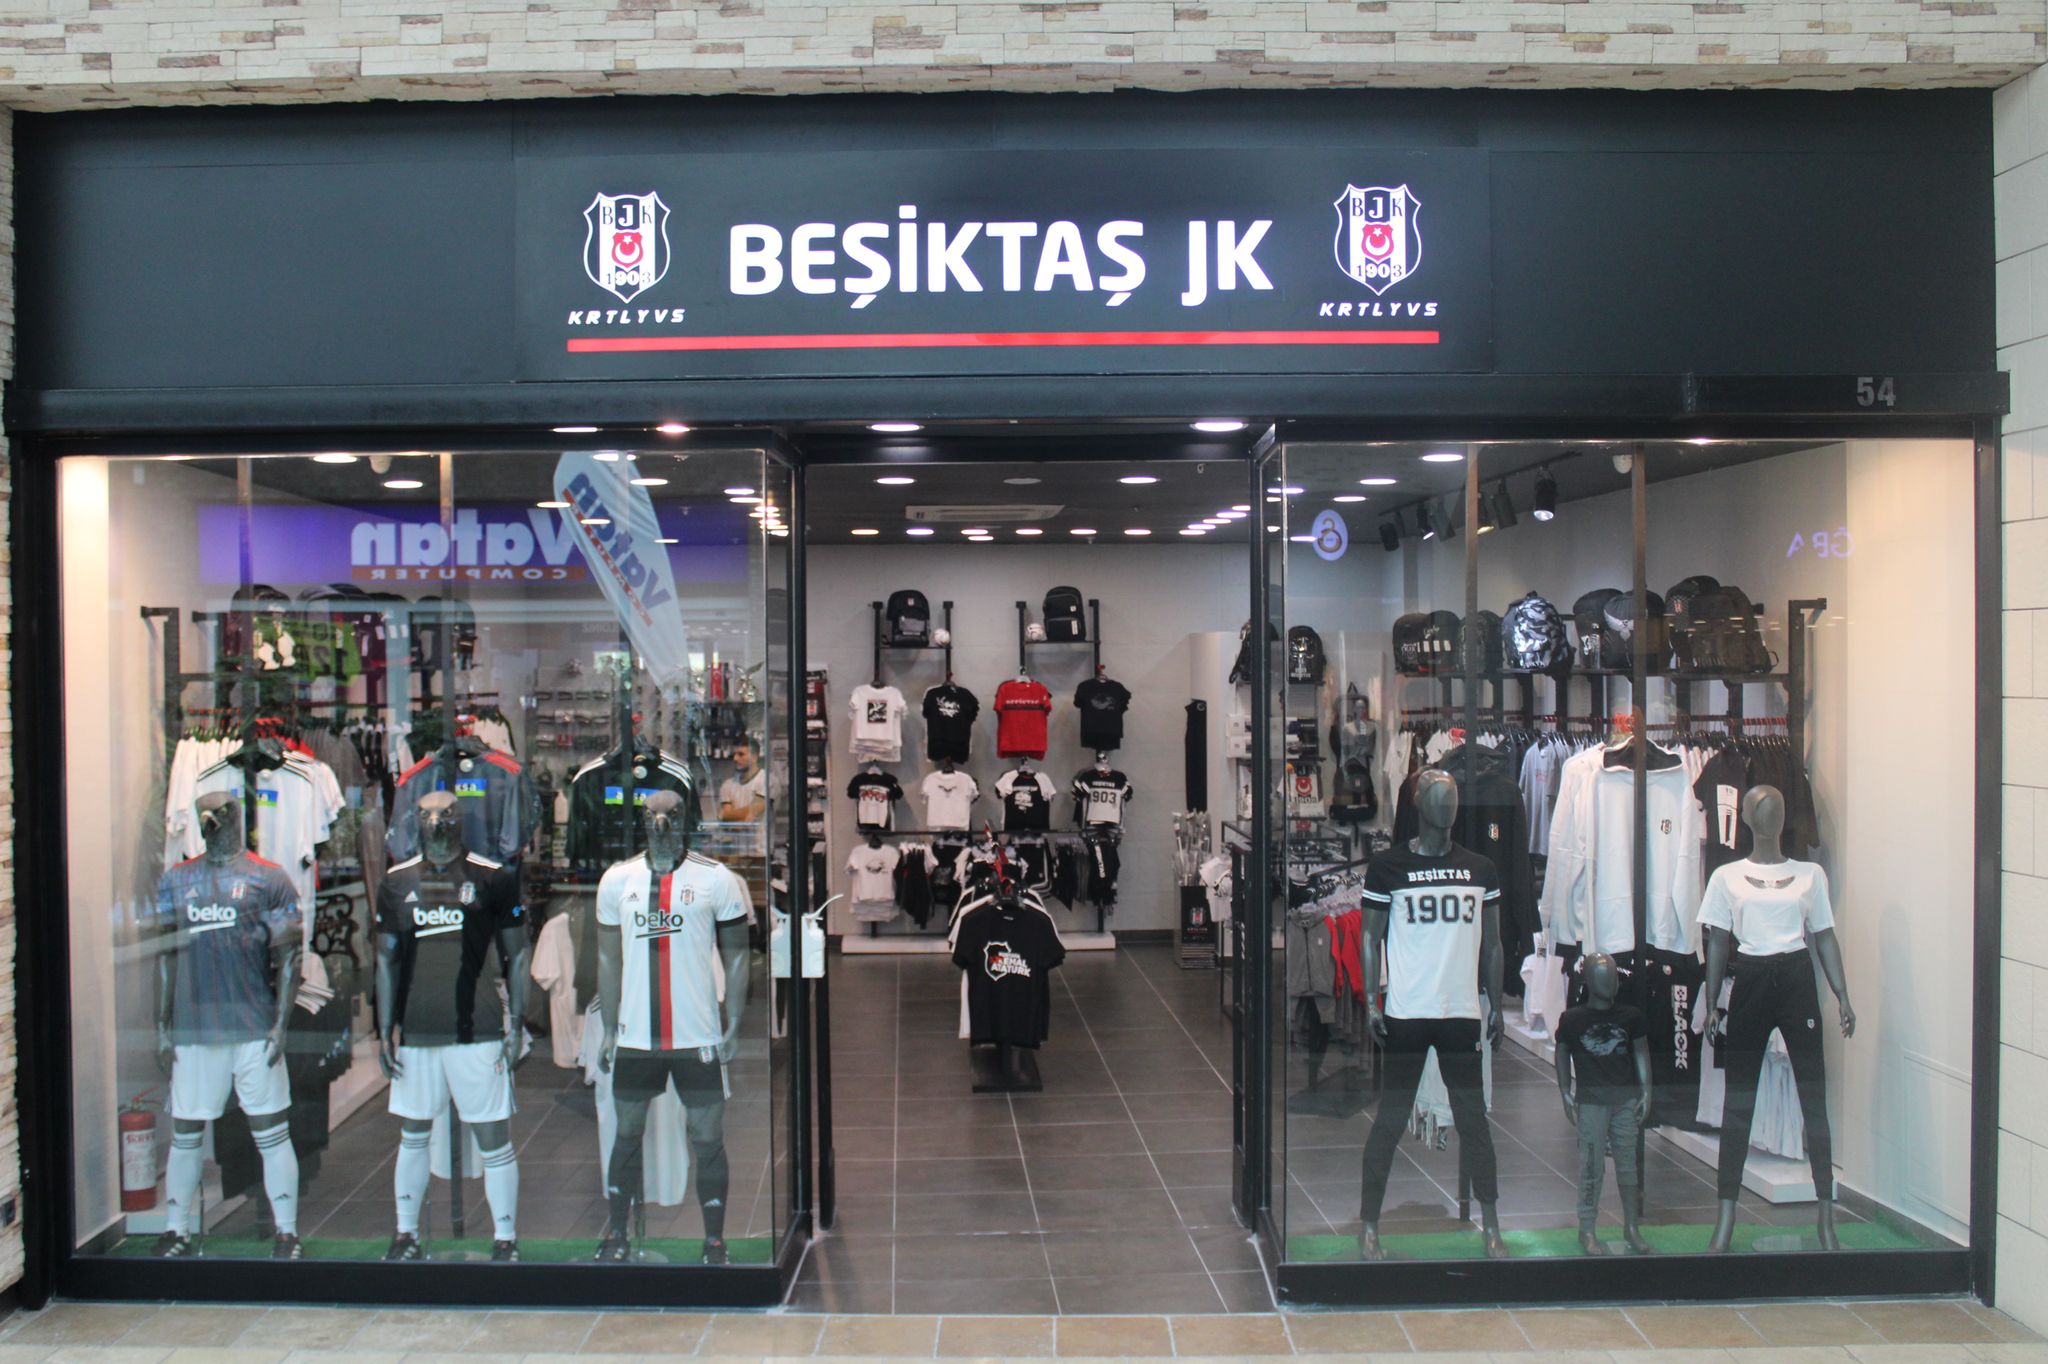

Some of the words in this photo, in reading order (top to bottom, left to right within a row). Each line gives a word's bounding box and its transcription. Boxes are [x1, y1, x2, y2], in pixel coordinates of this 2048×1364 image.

[602, 204, 653, 227] BJK
[1351, 196, 1404, 219] BJK
[730, 204, 1147, 309] BEŞİKTAŞ
[1181, 219, 1275, 307] JK
[606, 270, 652, 287] 1903
[1356, 263, 1403, 279] 1903
[567, 308, 686, 325] KRTLYVS
[1319, 302, 1439, 317] KRTLYVS
[1856, 376, 1897, 407] 54
[1090, 791, 1117, 804] 903
[1407, 868, 1472, 883] BEŞİKTAŞ
[187, 903, 237, 922] beko
[413, 905, 464, 926] beko
[634, 909, 684, 927] beko
[1404, 894, 1476, 924] 1903
